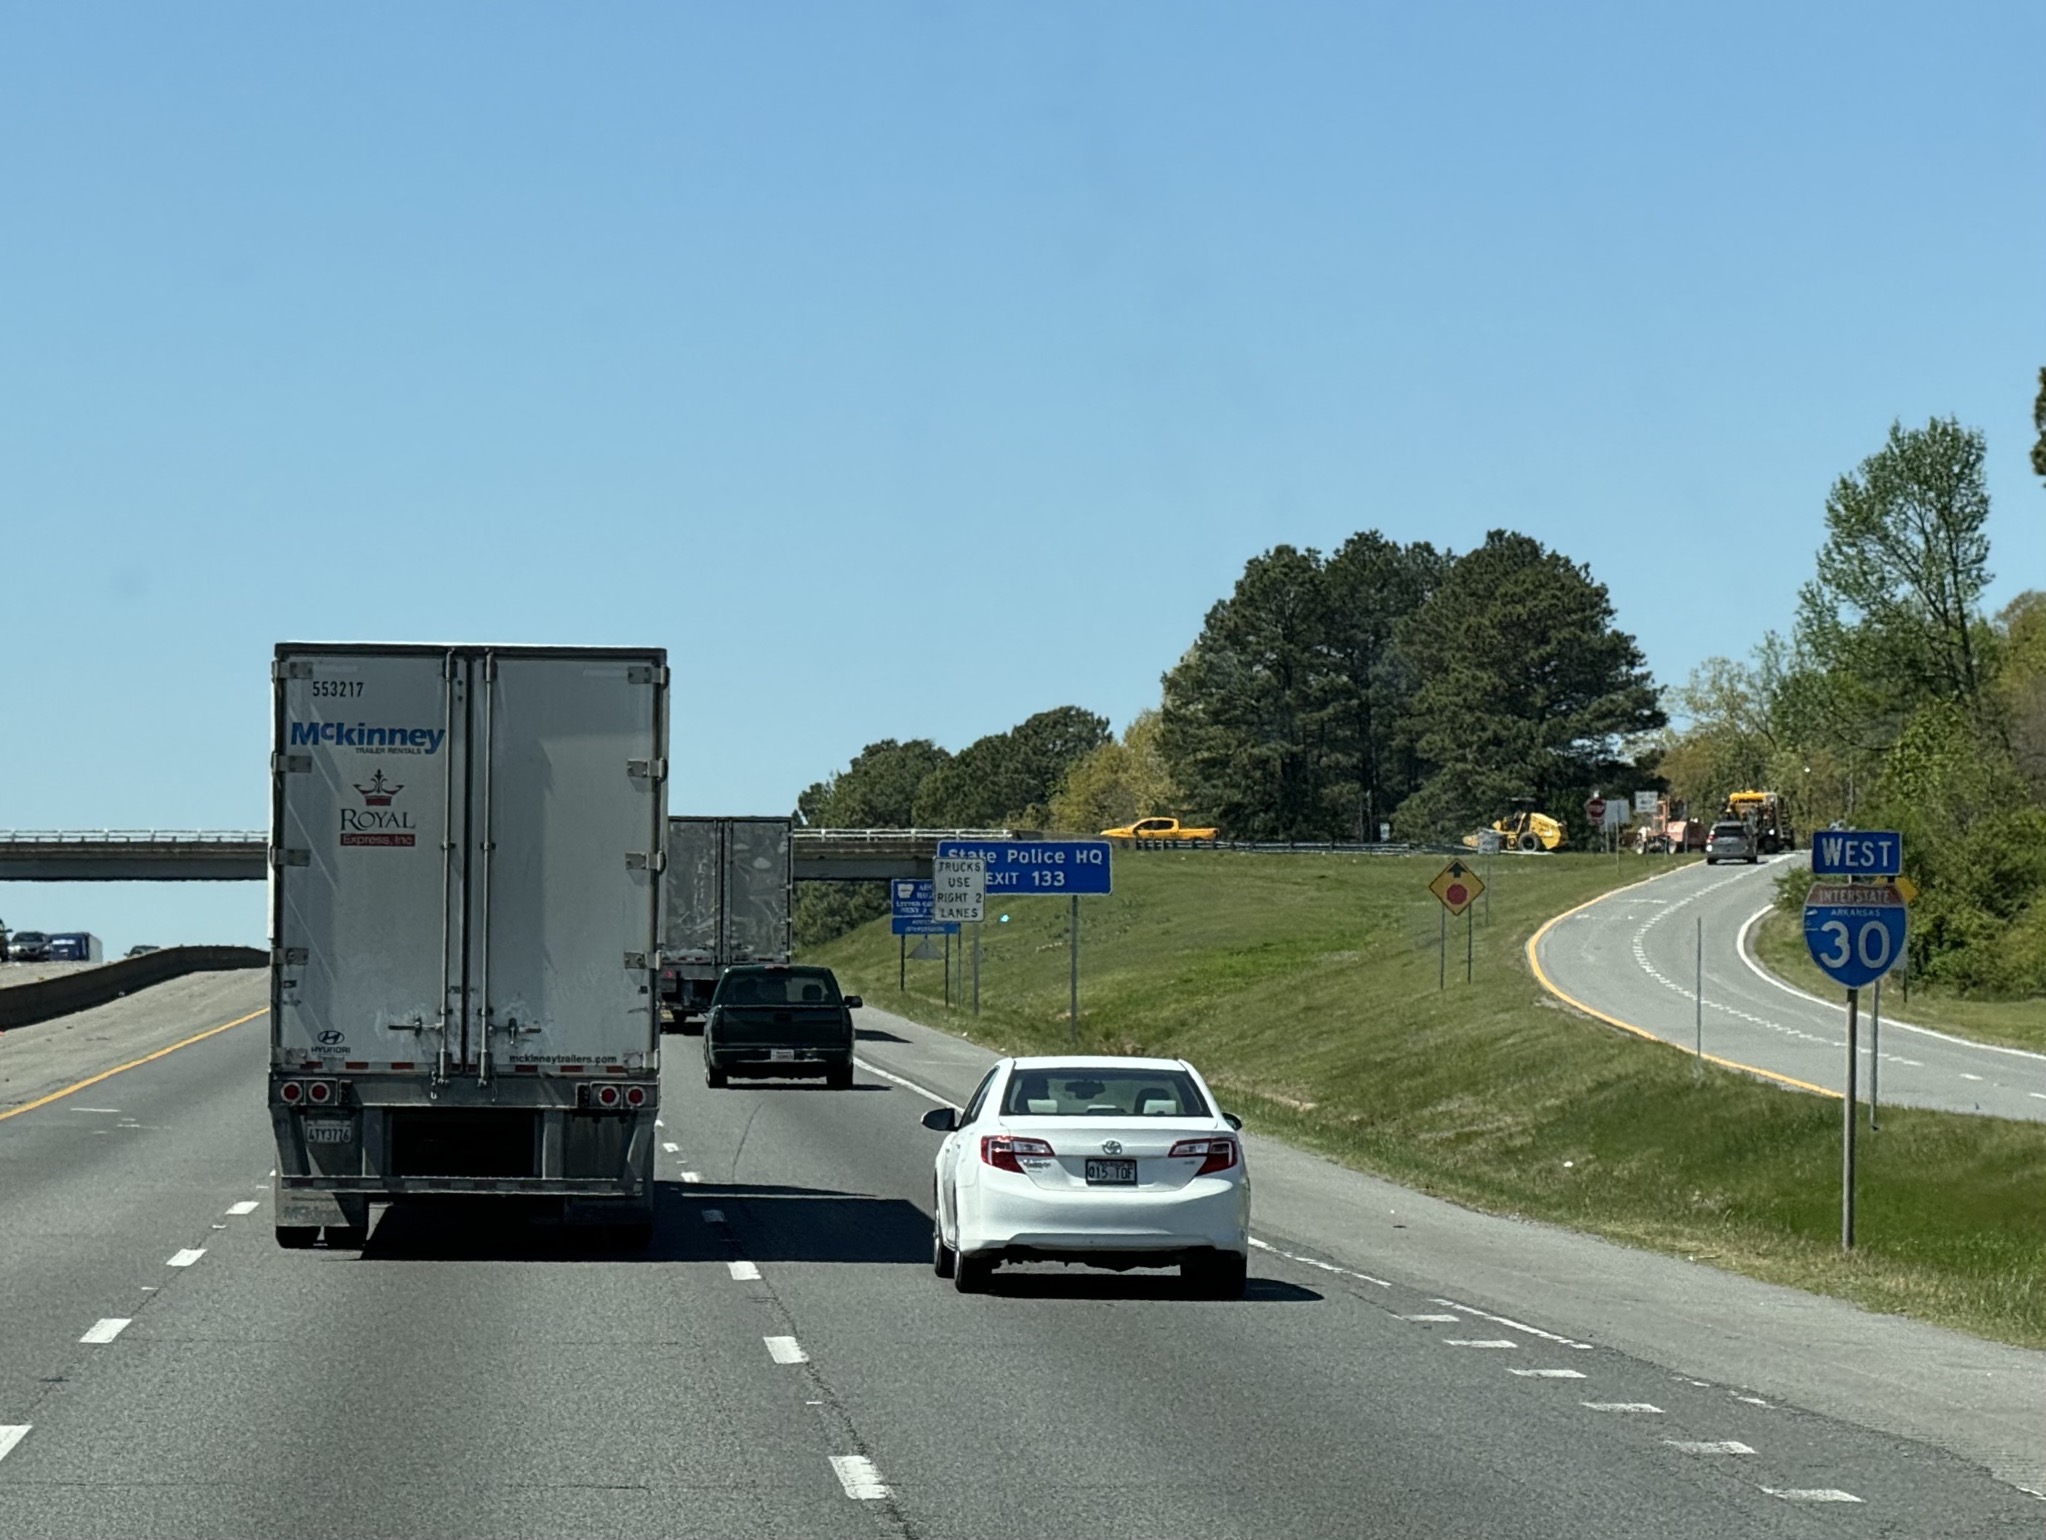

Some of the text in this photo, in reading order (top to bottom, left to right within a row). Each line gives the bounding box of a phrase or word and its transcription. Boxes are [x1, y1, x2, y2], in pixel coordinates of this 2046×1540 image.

[312, 681, 365, 698] 553217
[355, 747, 422, 755] TRAILER RENTALS
[1007, 848, 1066, 864] Police
[1076, 849, 1103, 865] HQ
[1821, 837, 1893, 868] WEST
[938, 861, 981, 872] TRUCKS
[948, 877, 971, 888] USE
[985, 870, 1066, 886] EXIT 133
[937, 892, 968, 903] RIGHT
[975, 892, 982, 903] 2
[1819, 889, 1890, 904] INTERSTATE
[941, 908, 978, 918] LANES
[1830, 908, 1881, 918] ARKANSAS
[1819, 920, 1891, 969] 30
[509, 1053, 618, 1066] mckinneytrailers.com
